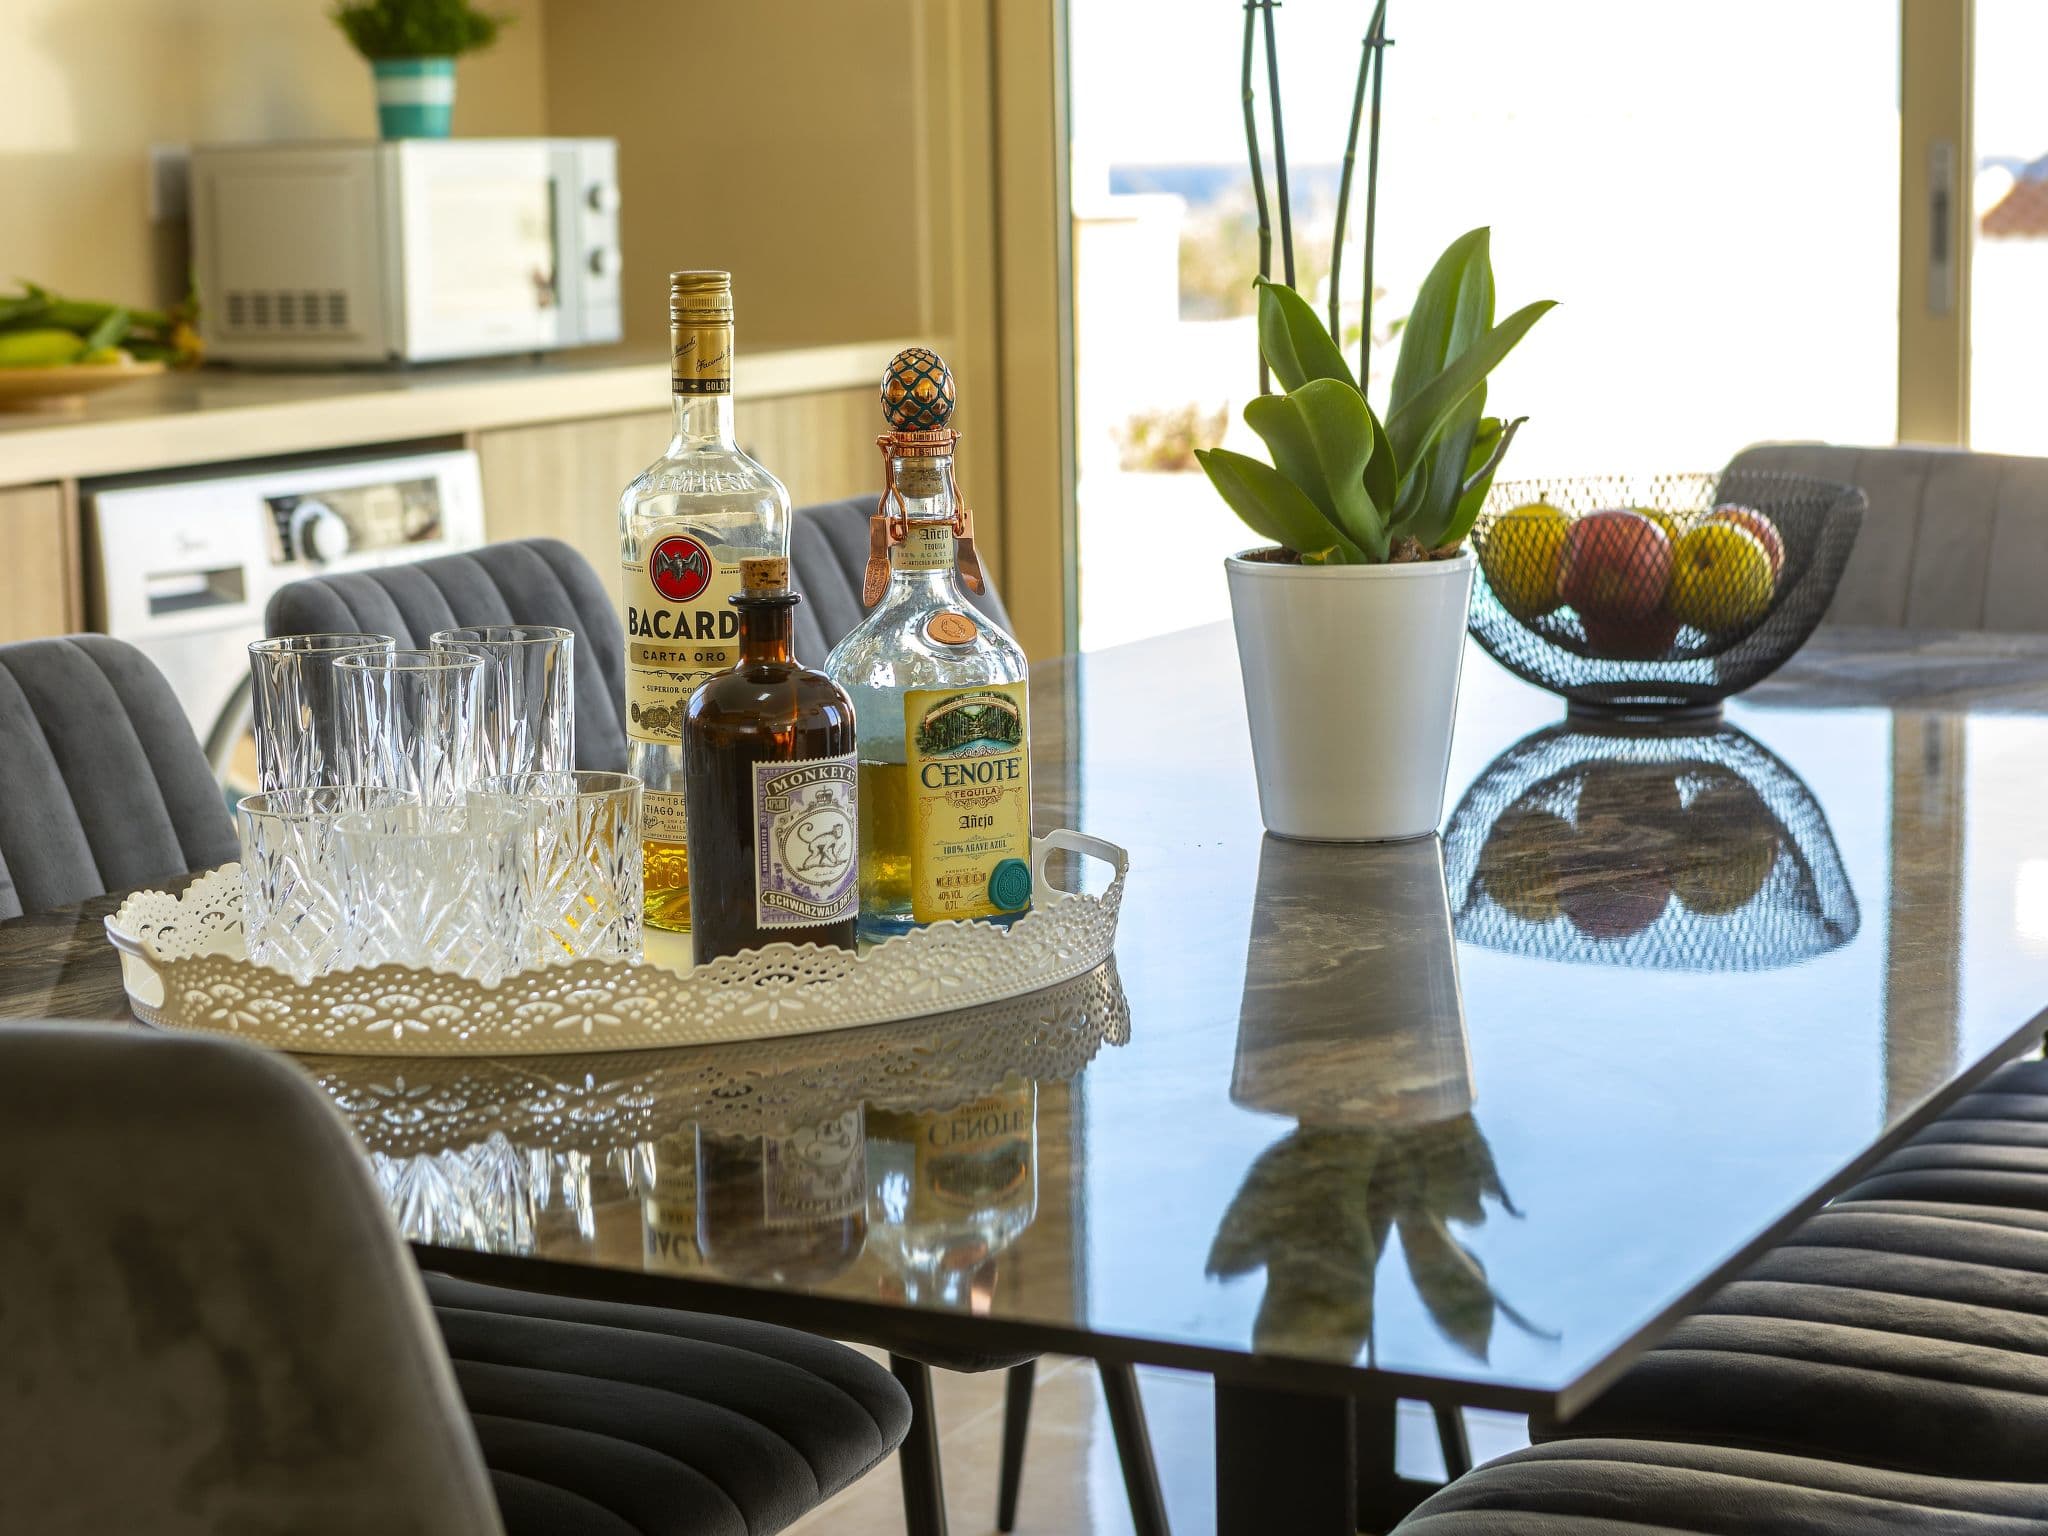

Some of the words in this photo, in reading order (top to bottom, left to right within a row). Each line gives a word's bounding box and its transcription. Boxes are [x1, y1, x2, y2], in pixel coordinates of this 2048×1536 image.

[705, 381, 725, 391] GOLD
[918, 528, 949, 541] Añejo
[629, 606, 740, 640] BACARD
[643, 650, 687, 662] CARTA
[694, 652, 726, 662] ORO
[646, 685, 680, 694] SUPERIOR
[921, 756, 1020, 789] CENOTE
[774, 766, 846, 794] MONKEY
[953, 787, 997, 798] TEQUILA
[667, 797, 686, 806] 186
[644, 804, 674, 816] TIAGO
[958, 814, 994, 830] Añejo
[943, 845, 964, 855] 100%
[965, 842, 989, 853] AGAVE
[989, 839, 1008, 849] AZUL
[936, 873, 987, 887] MEXICO
[769, 894, 839, 917] SCHWARZWALD
[839, 892, 851, 910] DRY
